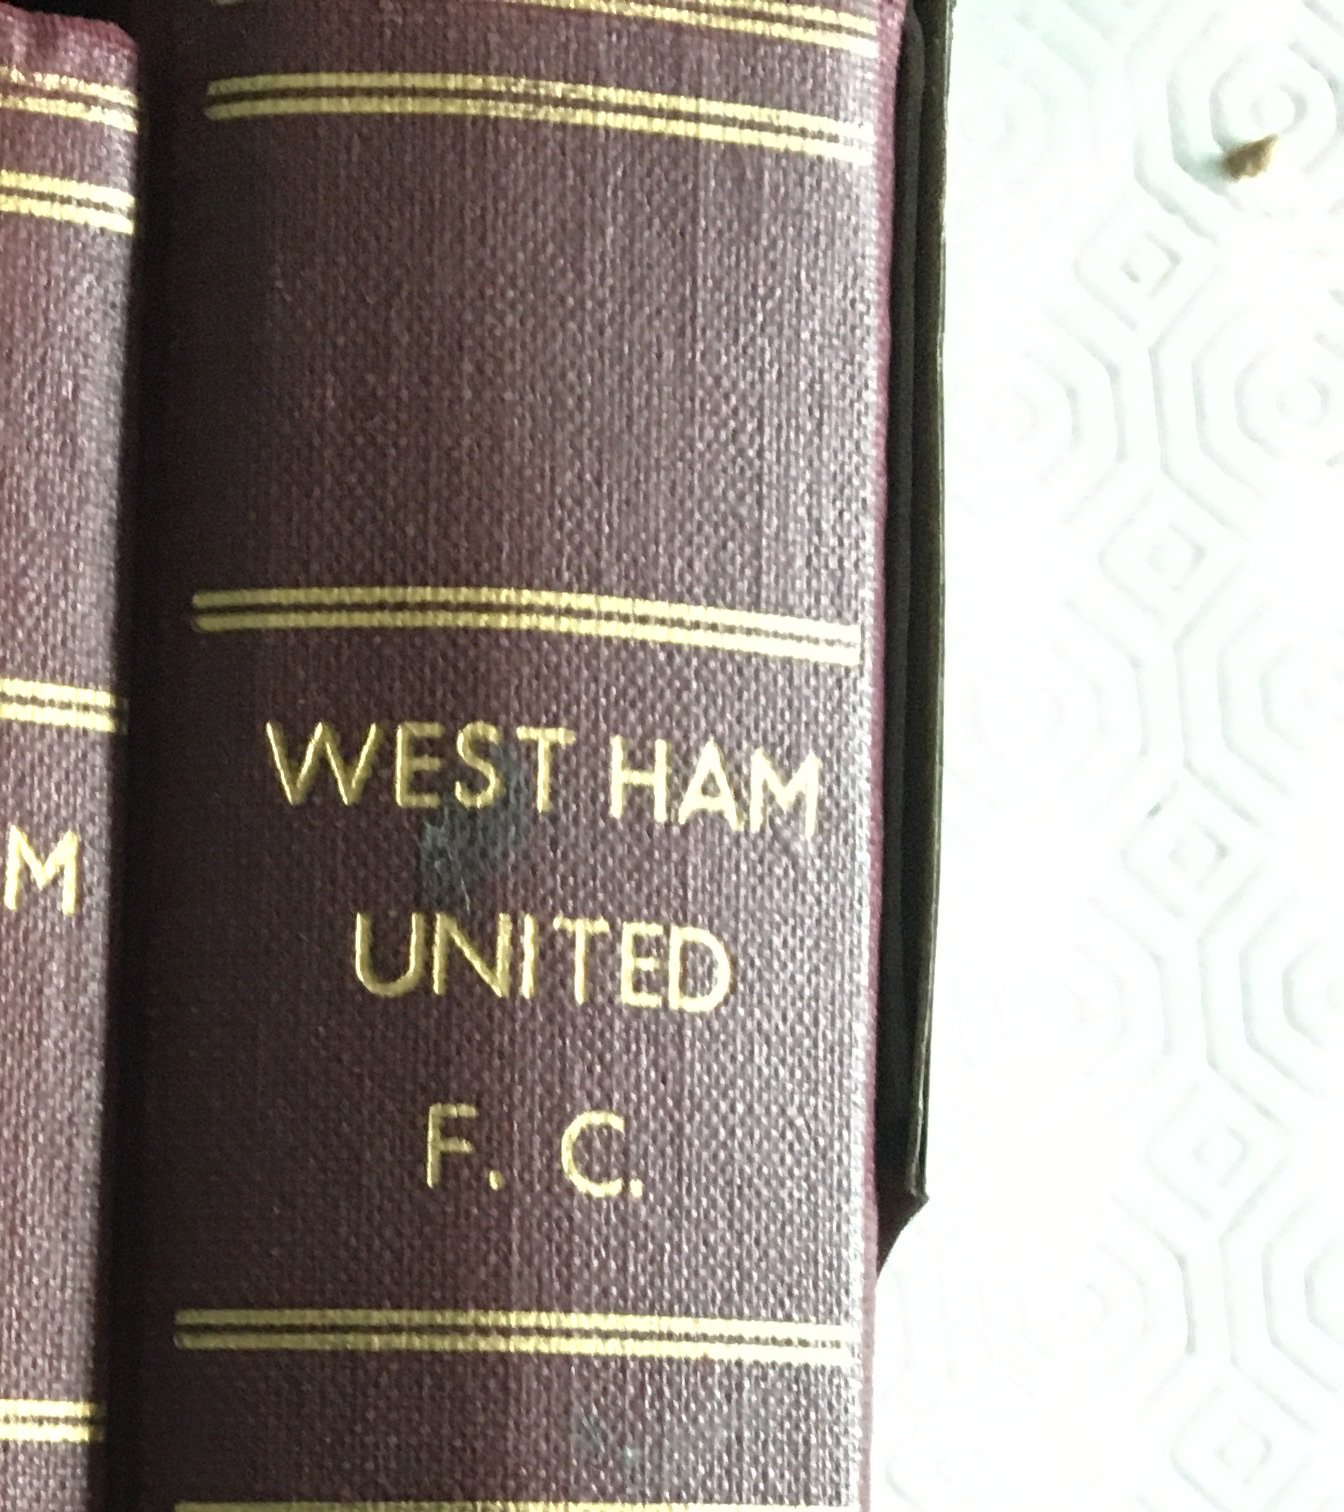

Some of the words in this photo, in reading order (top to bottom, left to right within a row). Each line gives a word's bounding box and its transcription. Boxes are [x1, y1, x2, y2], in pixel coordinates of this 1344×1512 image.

[266, 720, 575, 814] WEST
[608, 734, 822, 834] HAM
[353, 912, 733, 1010] UNITED
[424, 1103, 504, 1190] F.
[559, 1109, 644, 1199] C.
